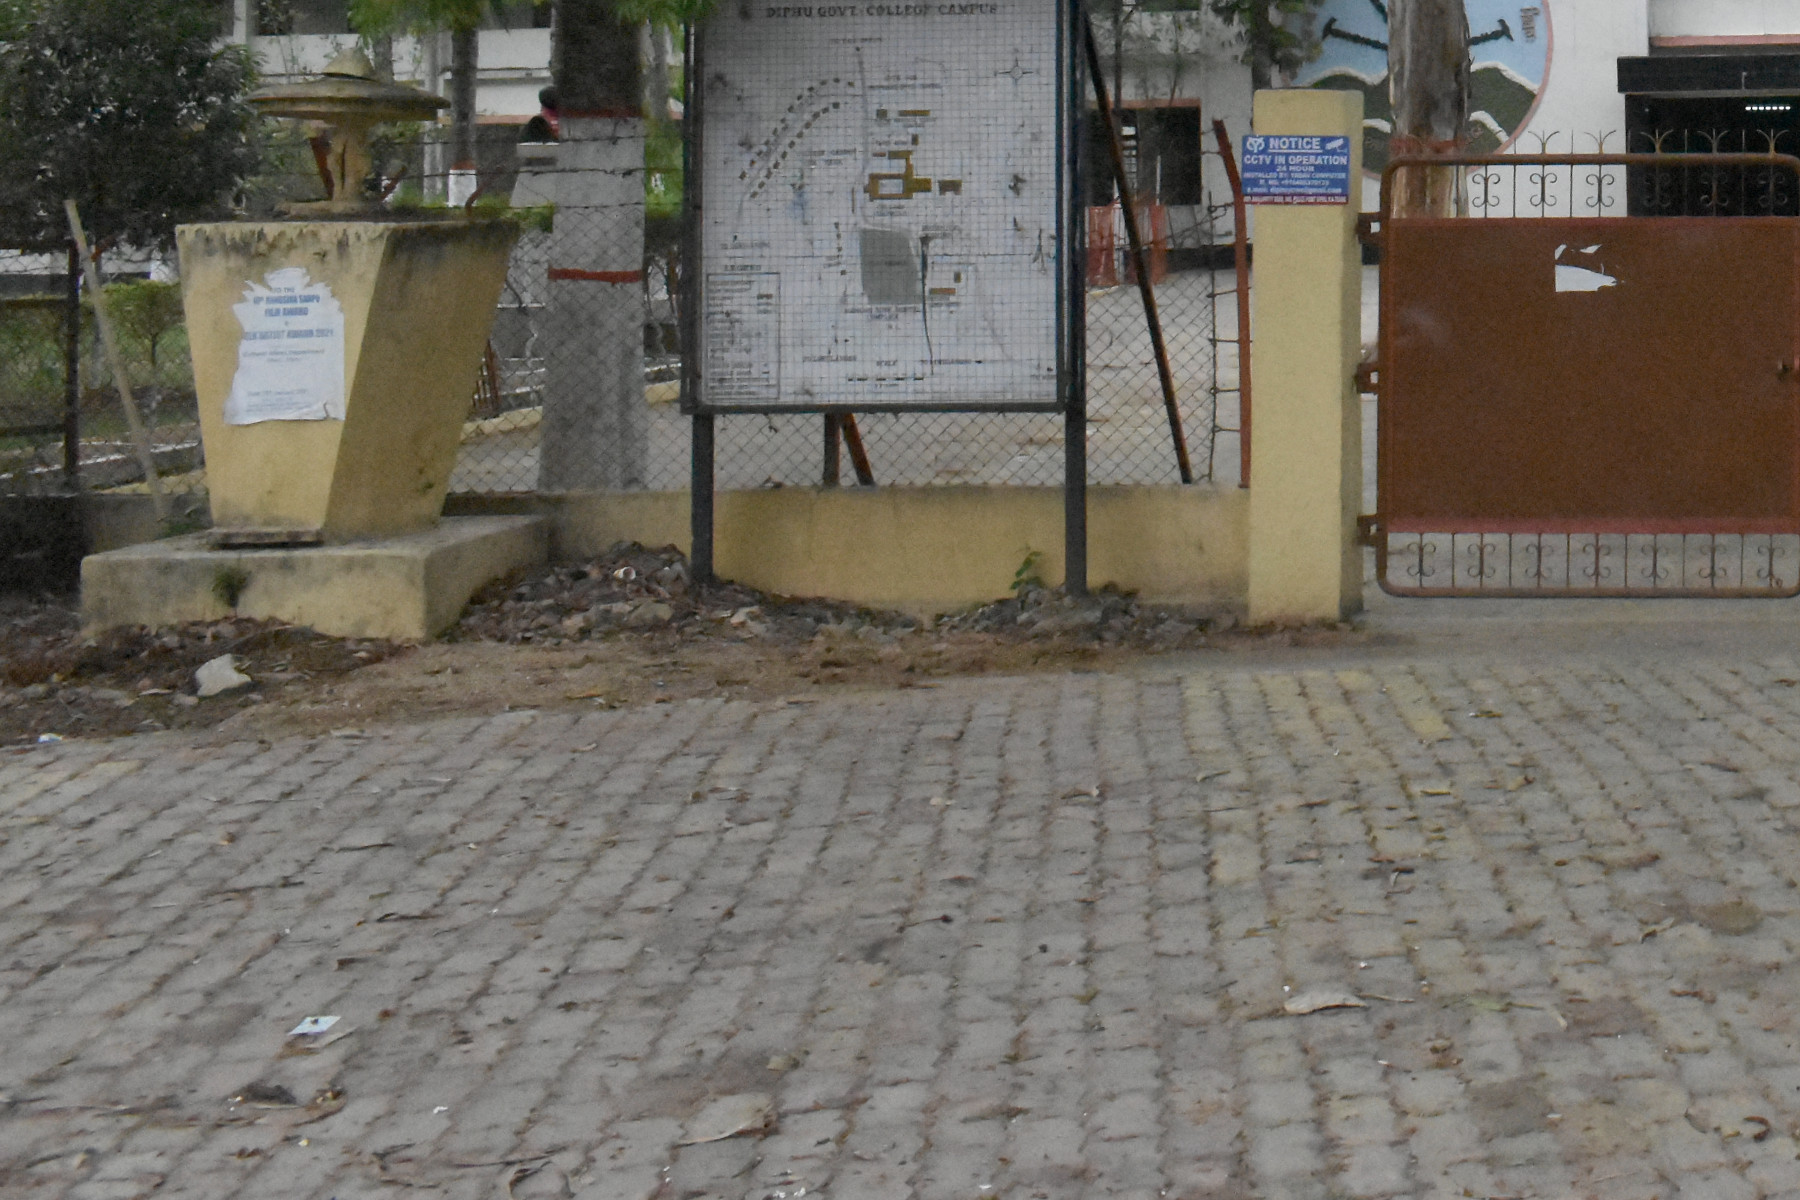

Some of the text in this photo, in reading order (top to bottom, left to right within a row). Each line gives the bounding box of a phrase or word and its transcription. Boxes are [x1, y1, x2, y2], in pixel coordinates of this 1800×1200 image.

[766, 6, 813, 18] DIPHU
[866, 4, 930, 16] COLLEGE
[938, 3, 997, 16] CAMPUS
[1269, 137, 1321, 149] NOTICE
[1244, 155, 1348, 165] CCTV IN OPERATION
